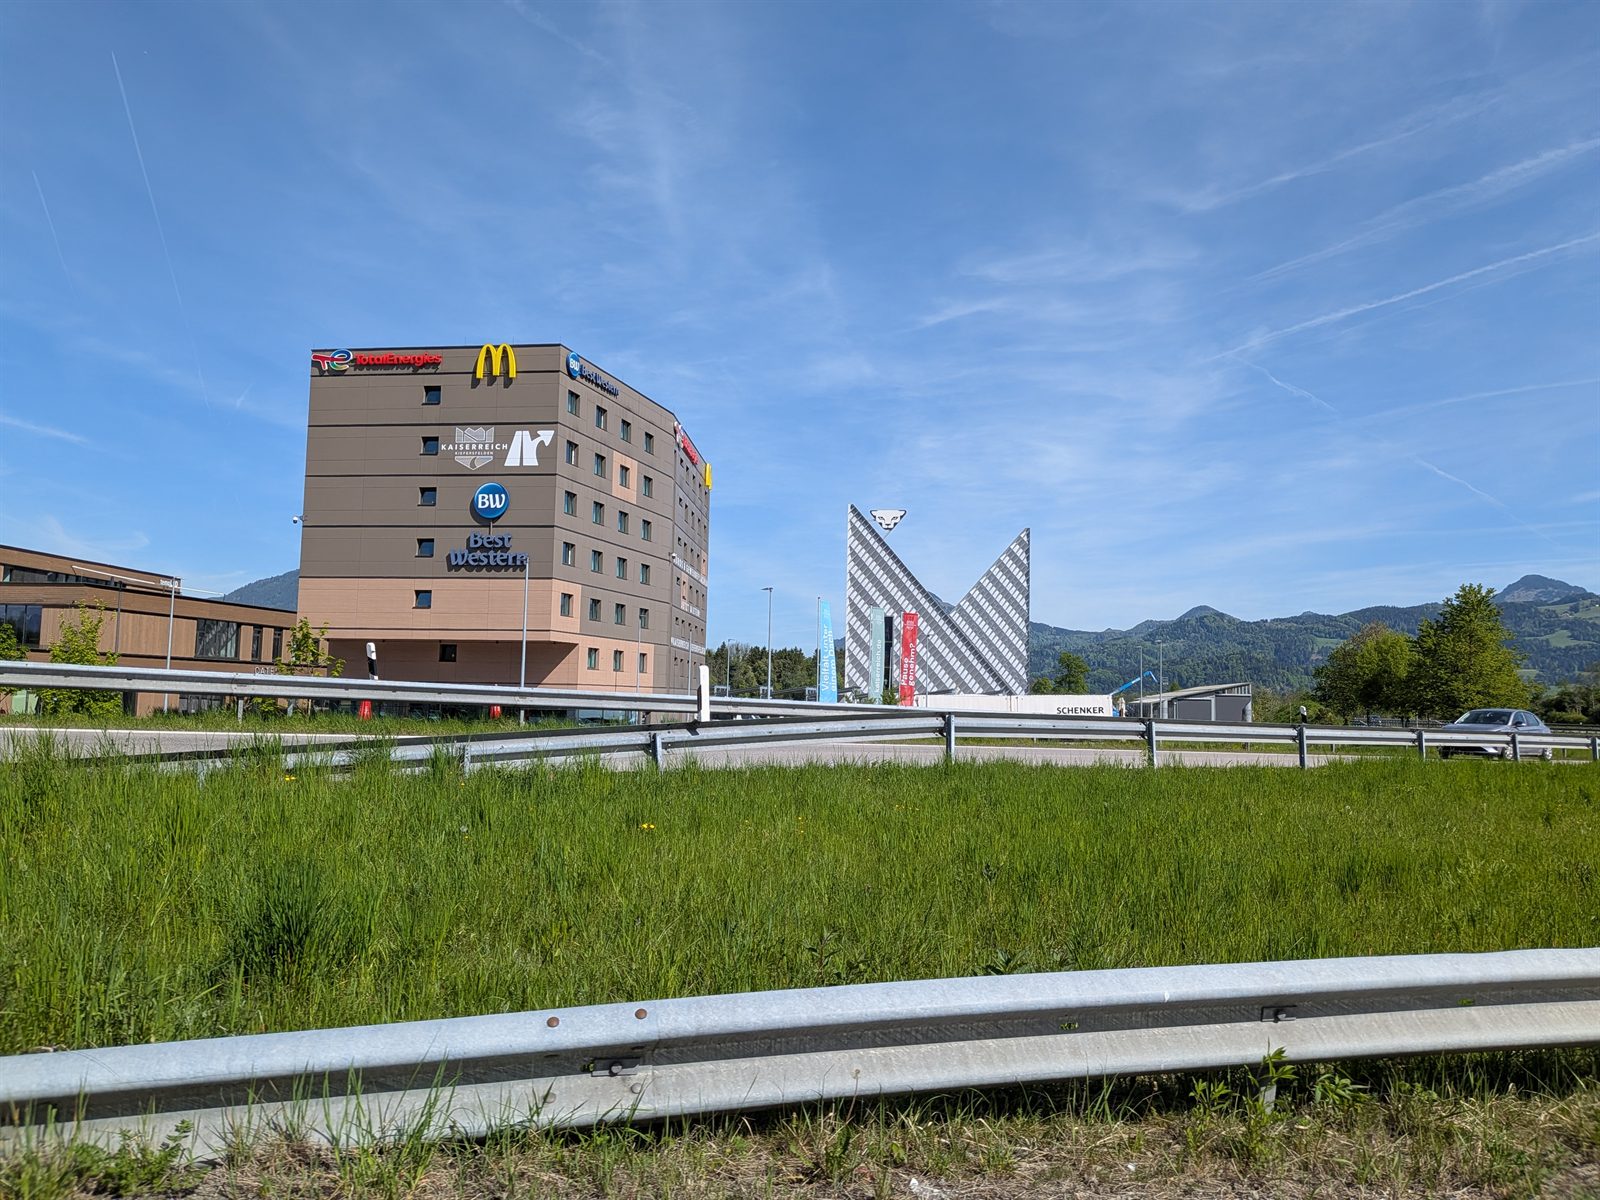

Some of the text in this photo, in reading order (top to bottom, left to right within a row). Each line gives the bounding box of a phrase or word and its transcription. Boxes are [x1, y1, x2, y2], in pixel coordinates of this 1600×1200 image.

[354, 352, 442, 367] TotalEnergies
[441, 443, 508, 451] KAISERREICH
[477, 493, 506, 509] BW
[470, 532, 512, 548] Best
[449, 549, 528, 566] Western
[901, 657, 909, 686] Pause
[908, 643, 916, 687] genehm?
[821, 655, 829, 692] Vielfalt
[1056, 706, 1105, 715] SCHENKER
